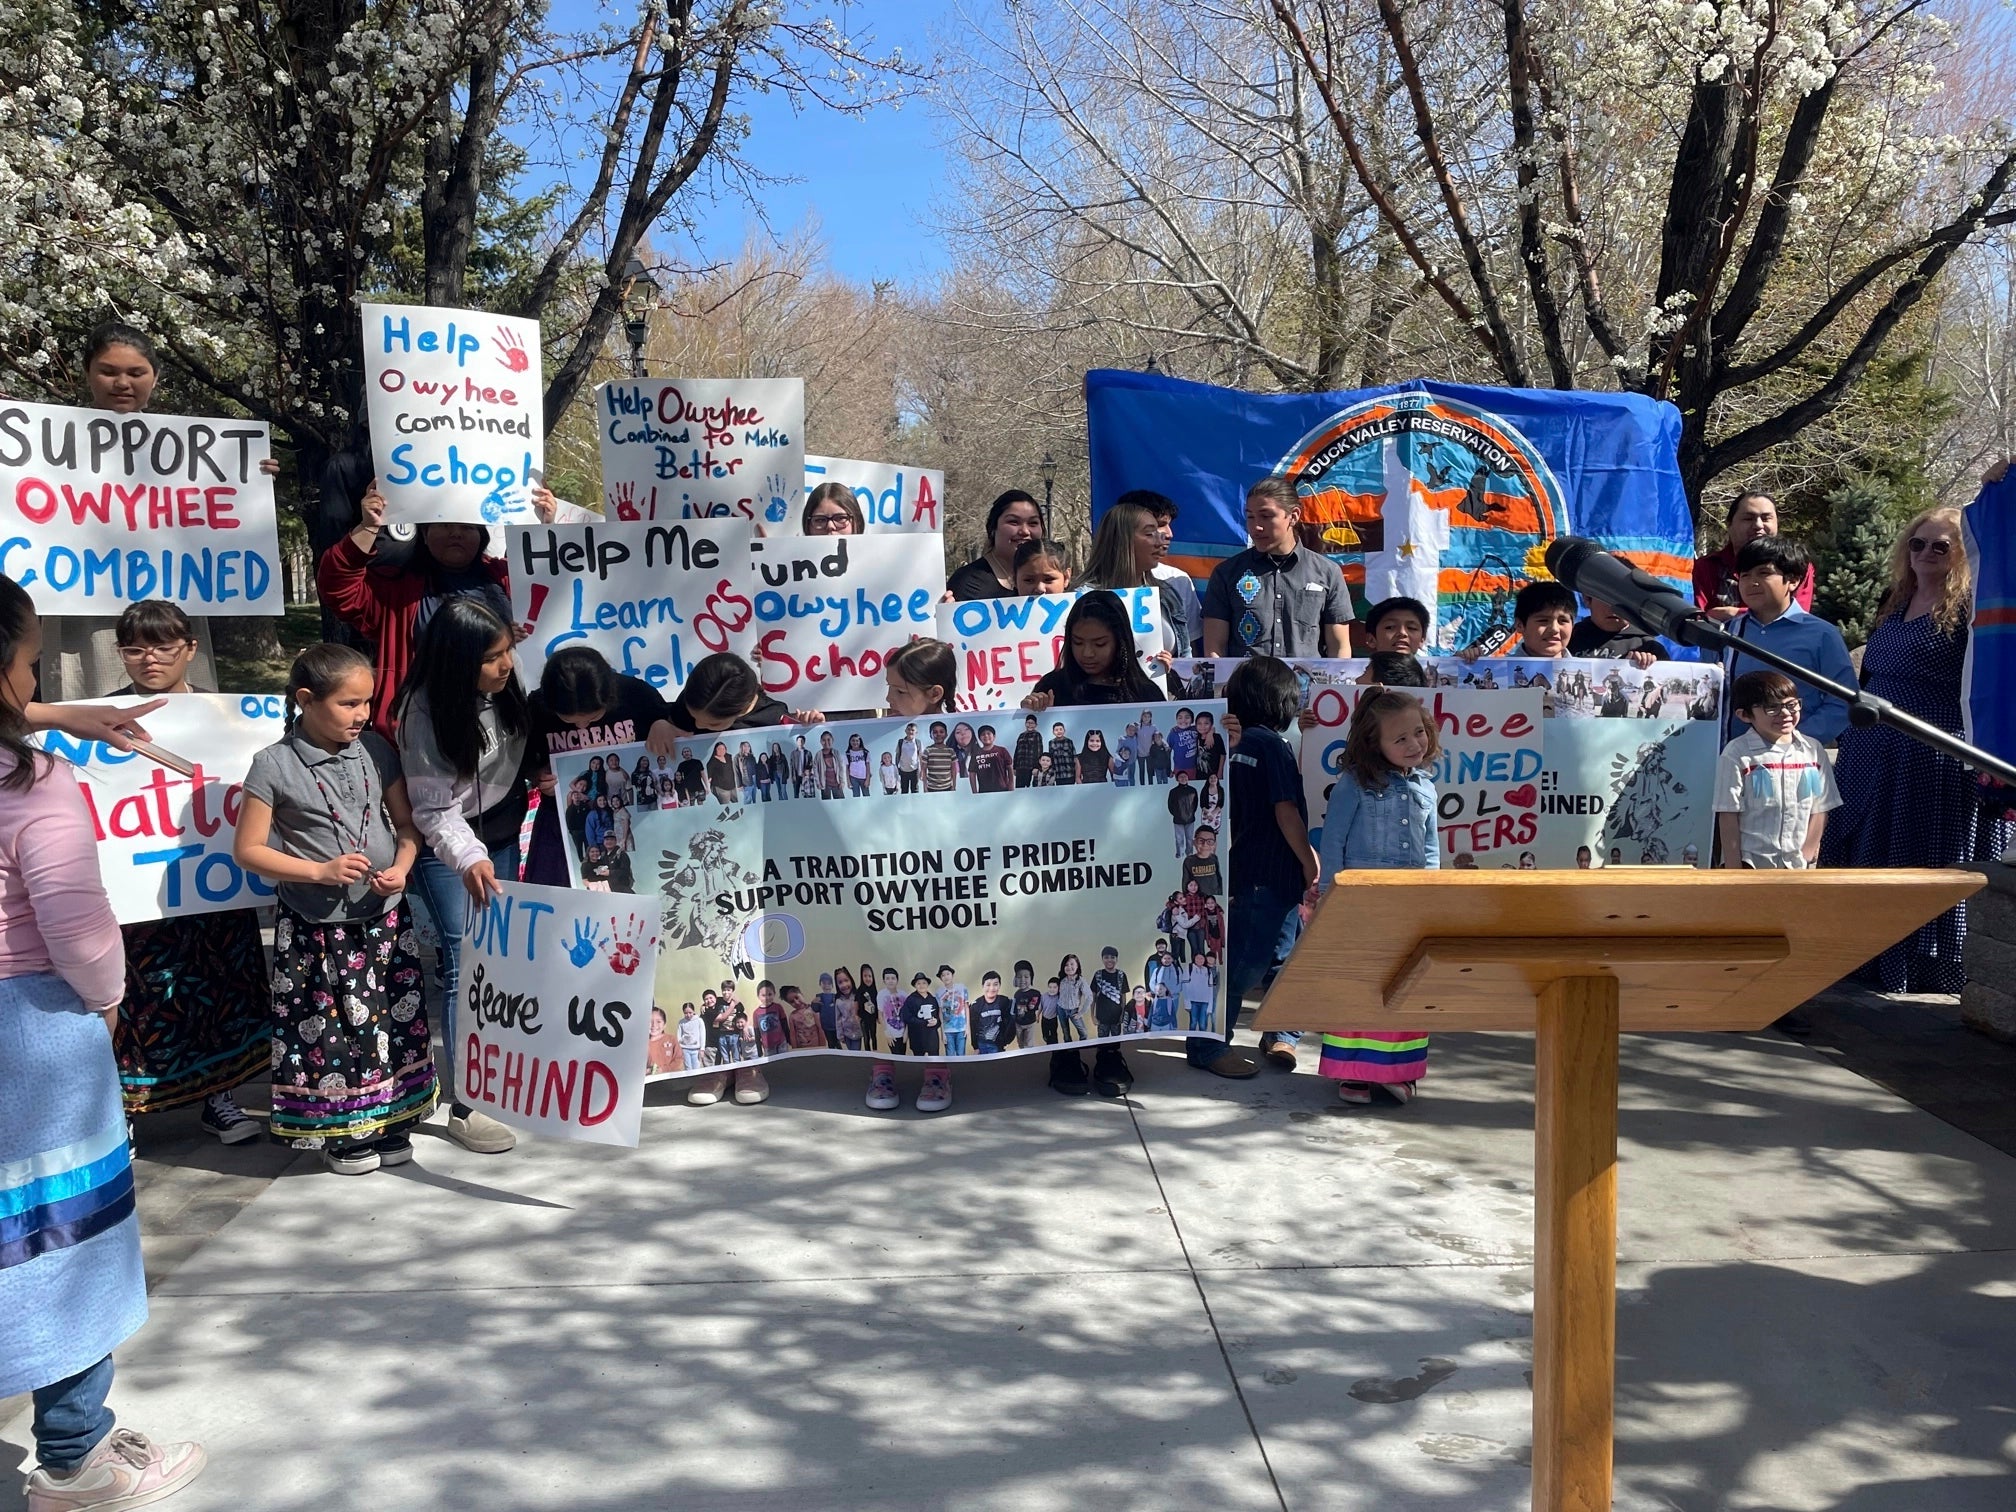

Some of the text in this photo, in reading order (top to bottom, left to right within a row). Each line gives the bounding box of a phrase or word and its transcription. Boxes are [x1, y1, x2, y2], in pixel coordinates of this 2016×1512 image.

[383, 315, 480, 367] Help
[379, 368, 518, 406] Owyhee
[606, 384, 764, 432] Help Owyhee
[1400, 399, 1420, 409] 1877
[0, 408, 264, 484] SUPPORT
[654, 445, 743, 480] Better
[702, 424, 735, 449] to
[745, 427, 790, 448] Make
[1308, 416, 1511, 476] DUCK VALLEY RESERVATION
[386, 444, 532, 488] School
[15, 477, 241, 532] OWYHEE
[911, 475, 937, 530] A
[0, 537, 270, 603] COMBINED
[522, 525, 720, 580] Help Me
[750, 539, 848, 587] und
[570, 578, 684, 631] Learn
[953, 586, 1154, 637] OWYE
[761, 629, 904, 694] Scho
[546, 719, 636, 751] INCREASE
[763, 838, 1095, 882] A TRADITION OF PRIDE!
[715, 862, 1152, 915] SUPPORT OWYHEE COMBINED
[867, 902, 998, 932] SCHOOL!
[567, 995, 632, 1048] us
[465, 1033, 619, 1127] BEHIND
